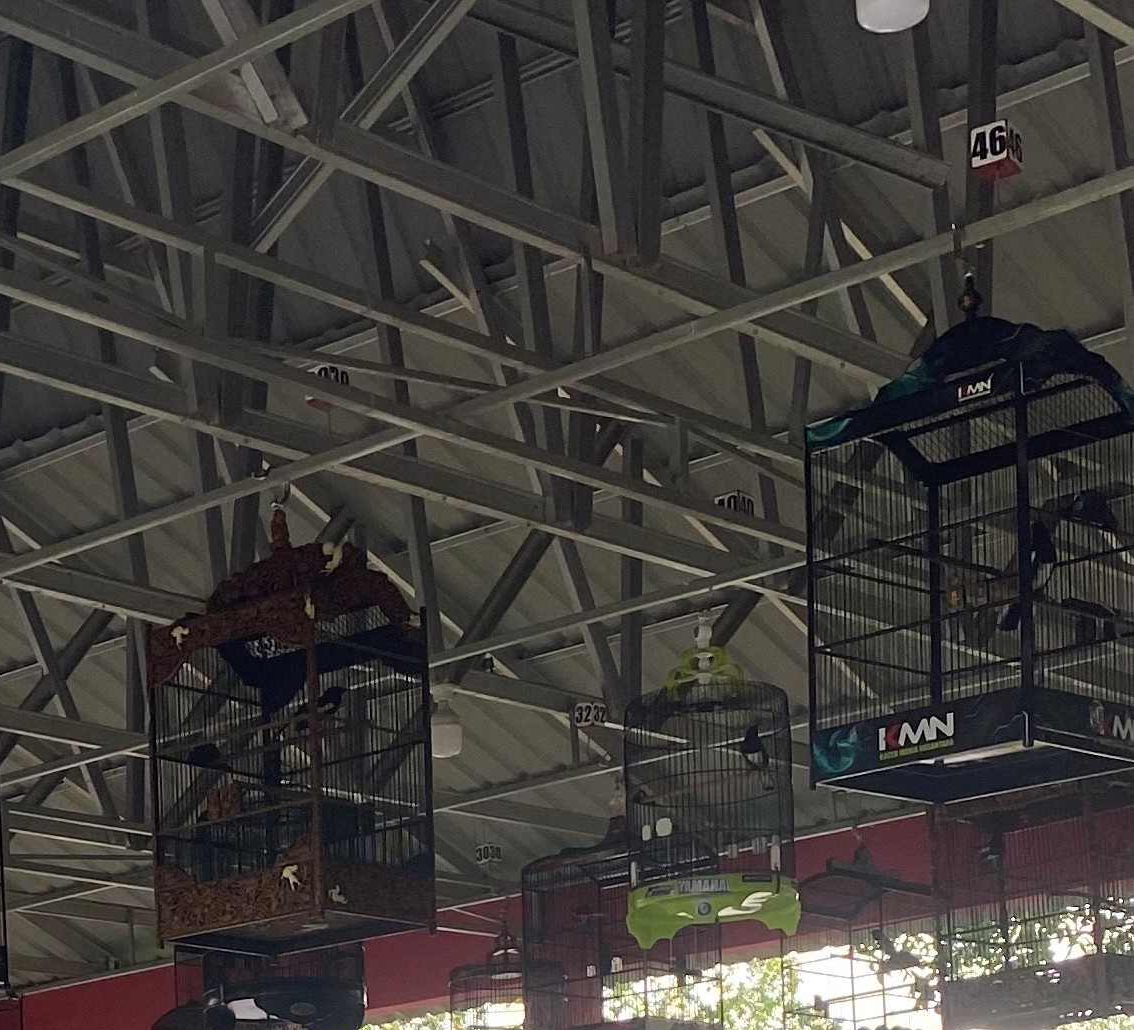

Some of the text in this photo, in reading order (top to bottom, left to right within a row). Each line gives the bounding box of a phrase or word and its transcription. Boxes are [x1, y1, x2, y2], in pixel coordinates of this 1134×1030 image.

[971, 125, 1006, 160] 46
[575, 705, 592, 723] 32
[593, 704, 606, 723] 32
[878, 712, 954, 752] KMN
[677, 879, 728, 894] YAMAHA
